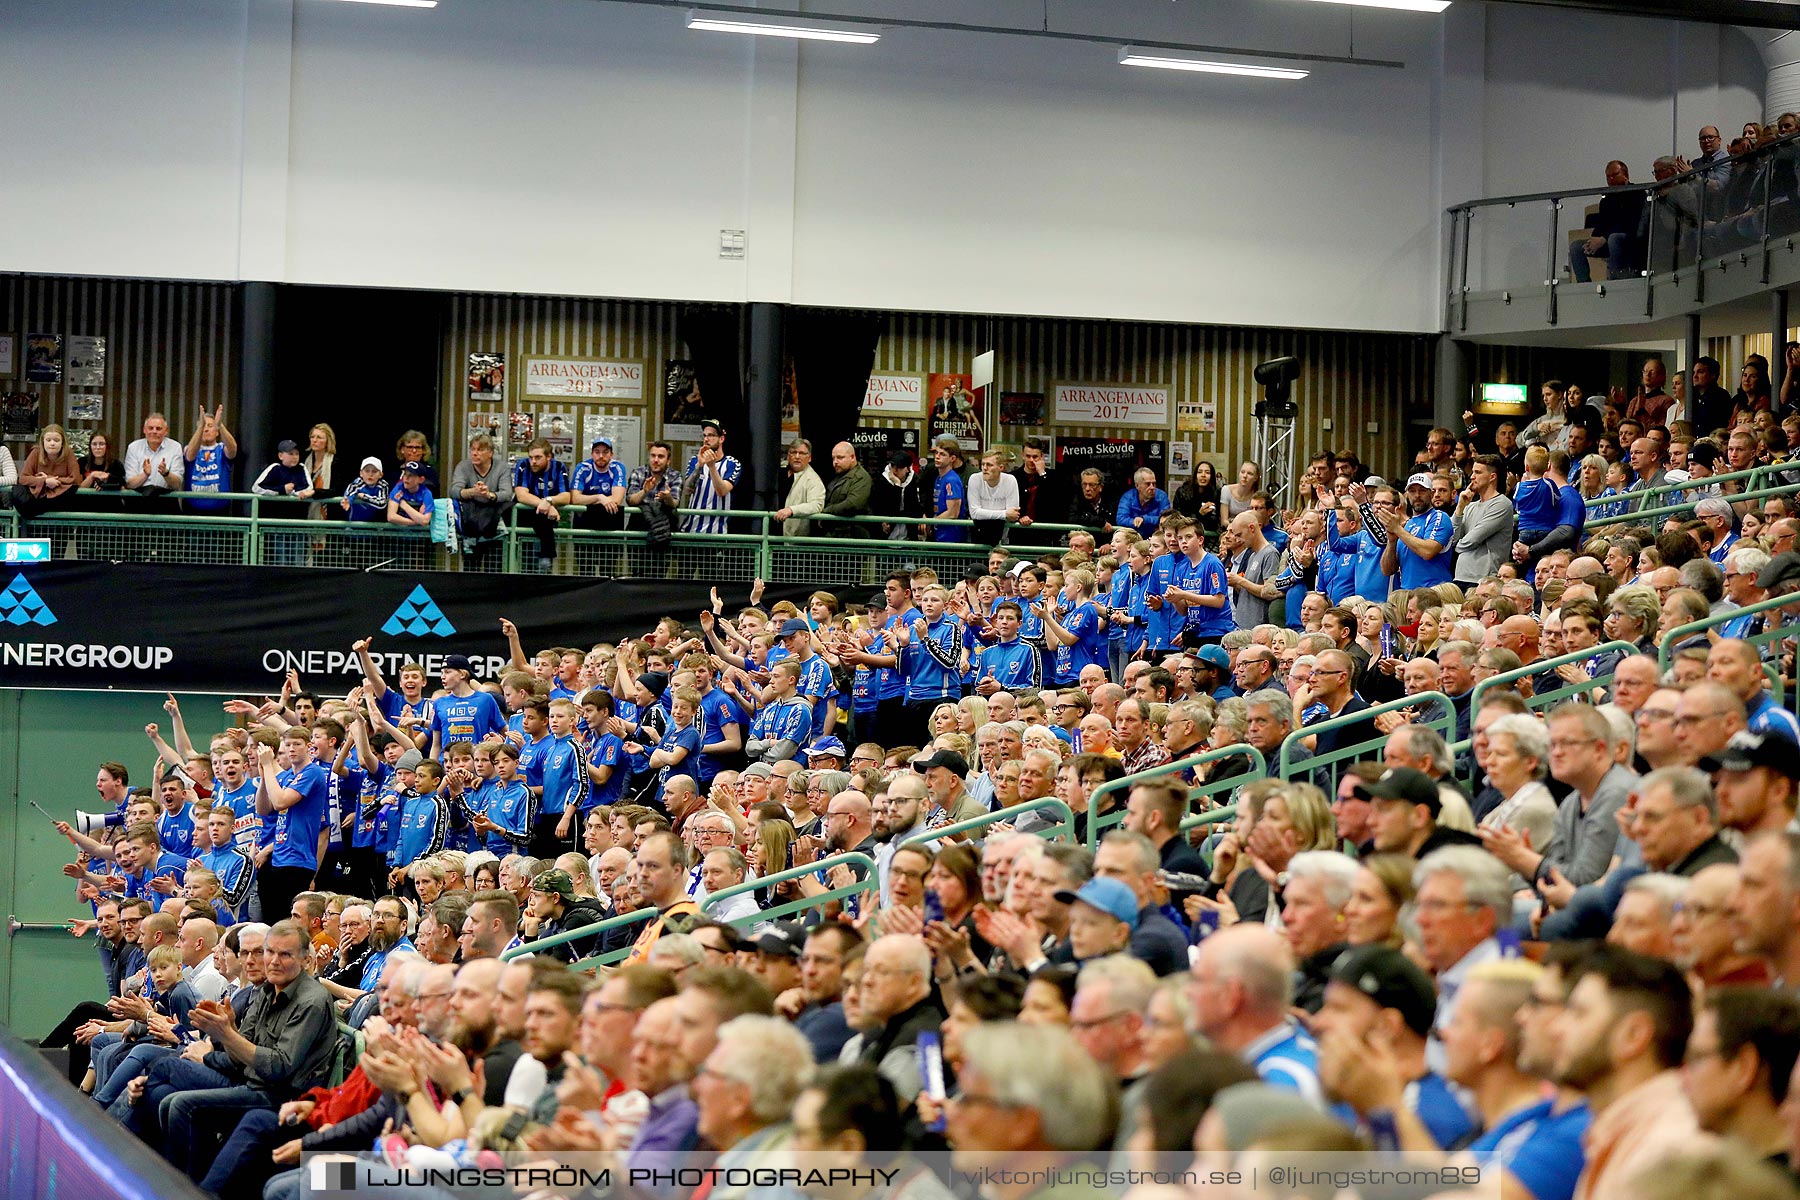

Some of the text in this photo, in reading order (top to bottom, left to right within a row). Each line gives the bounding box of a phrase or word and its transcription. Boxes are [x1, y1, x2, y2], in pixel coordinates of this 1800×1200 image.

[530, 363, 640, 380] ARRANGEMANG
[566, 379, 604, 394] 2015
[869, 379, 919, 393] EMANG
[867, 392, 884, 407] 16
[1058, 389, 1165, 405] ARRANGEMANG
[1093, 405, 1129, 419] 2017
[933, 420, 977, 430] CHRISTMAS
[1062, 442, 1135, 456] Arena Skövde
[0, 643, 173, 669] NERGROUP
[262, 649, 537, 679] ONEPARTNEGR
[446, 707, 456, 717] 14
